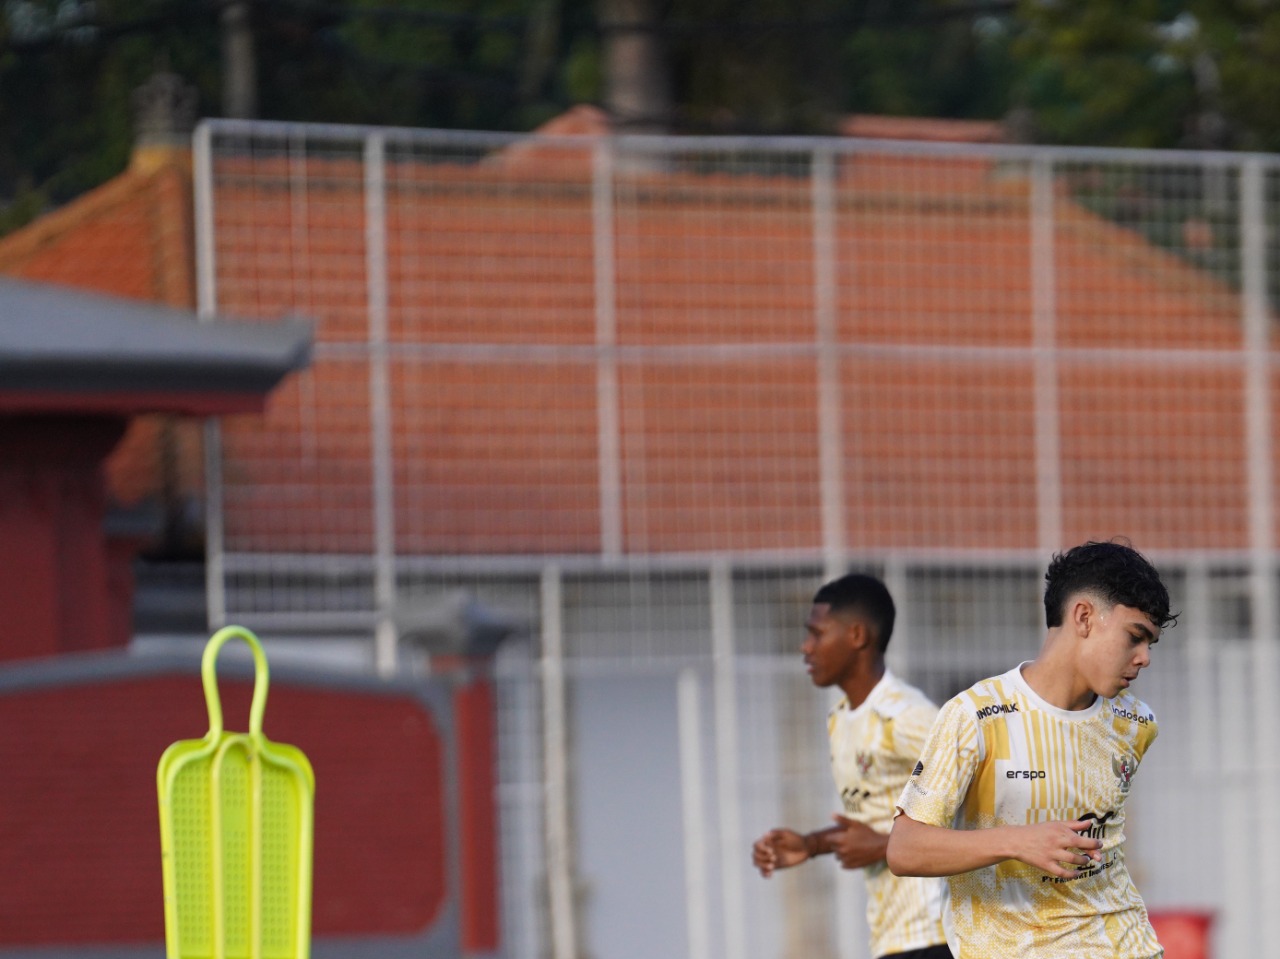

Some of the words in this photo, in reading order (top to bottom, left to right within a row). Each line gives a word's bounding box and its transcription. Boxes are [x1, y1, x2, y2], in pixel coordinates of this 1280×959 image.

[976, 703, 1019, 720] INDOMILK
[1111, 704, 1149, 726] indosat
[1006, 770, 1046, 781] erspo
